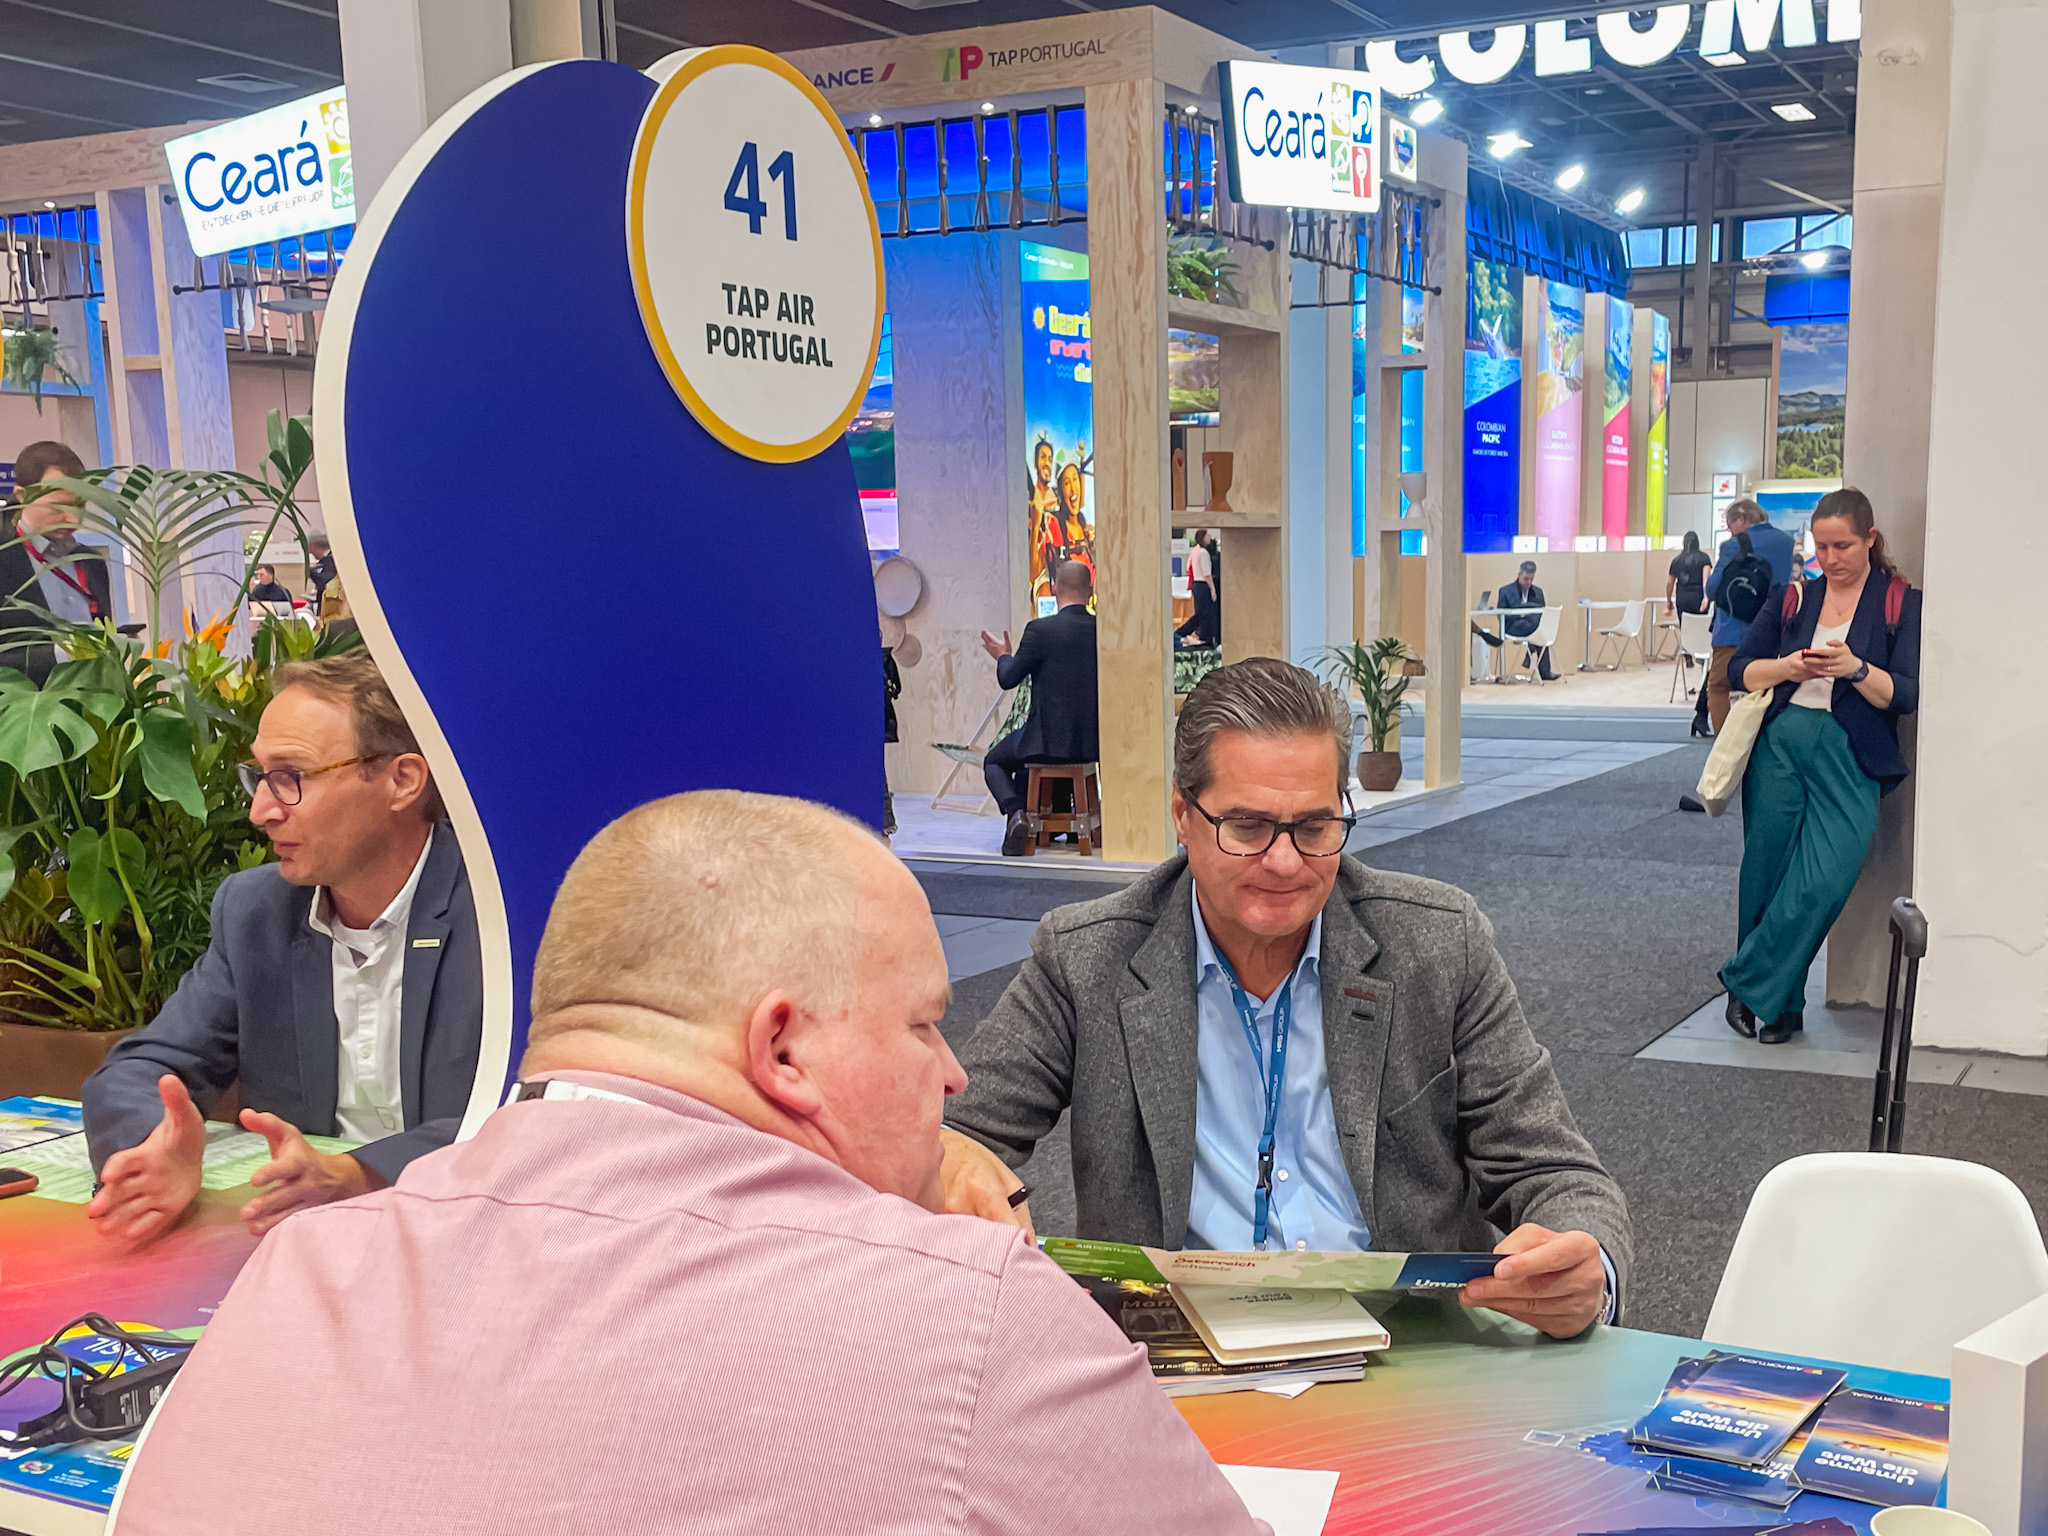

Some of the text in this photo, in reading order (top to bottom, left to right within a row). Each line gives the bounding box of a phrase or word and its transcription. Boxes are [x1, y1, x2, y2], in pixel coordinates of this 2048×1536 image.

[1365, 0, 1861, 95] COLOM
[812, 66, 873, 89] ANCE
[1242, 86, 1327, 160] Ceará
[185, 120, 323, 212] Ceará
[723, 141, 798, 241] 41
[721, 281, 815, 326] TAP AIR
[706, 323, 833, 368] PORTUGAL
[1738, 1357, 1803, 1372] AIR PORTUGAL
[1851, 1391, 1923, 1407] AIR PORTUGAL
[1671, 1415, 1762, 1439] Umarme
[1680, 1409, 1769, 1431] die Welt
[1814, 1457, 1915, 1486] Umarme
[1821, 1450, 1919, 1476] die Welt
